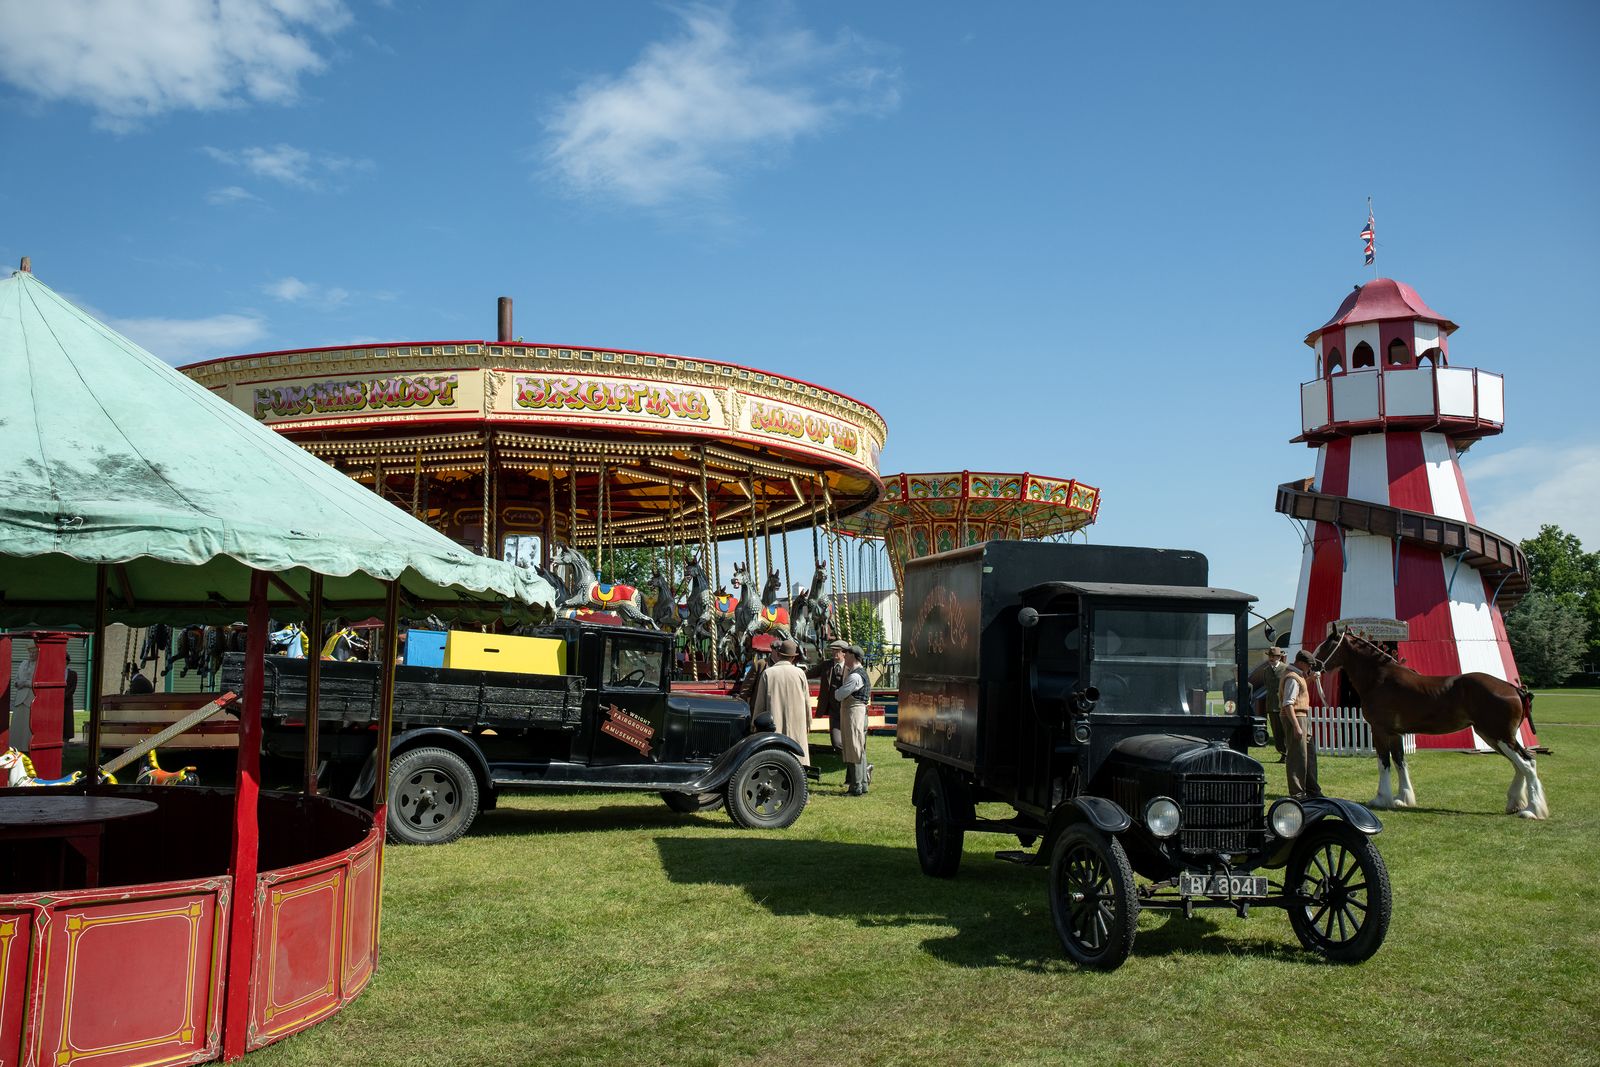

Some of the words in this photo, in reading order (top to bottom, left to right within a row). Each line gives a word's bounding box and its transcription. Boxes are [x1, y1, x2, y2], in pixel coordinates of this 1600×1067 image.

[254, 387, 313, 421] FOR
[310, 381, 368, 413] THE
[369, 374, 458, 408] MOST
[515, 377, 711, 420] EXCITING
[751, 401, 804, 438] RIDE
[805, 415, 830, 444] OF
[613, 713, 652, 736] FAIRGROUND
[629, 711, 651, 726] WRIGHT
[605, 724, 646, 748] AMUSEMENTS
[1218, 877, 1257, 895] 8041
